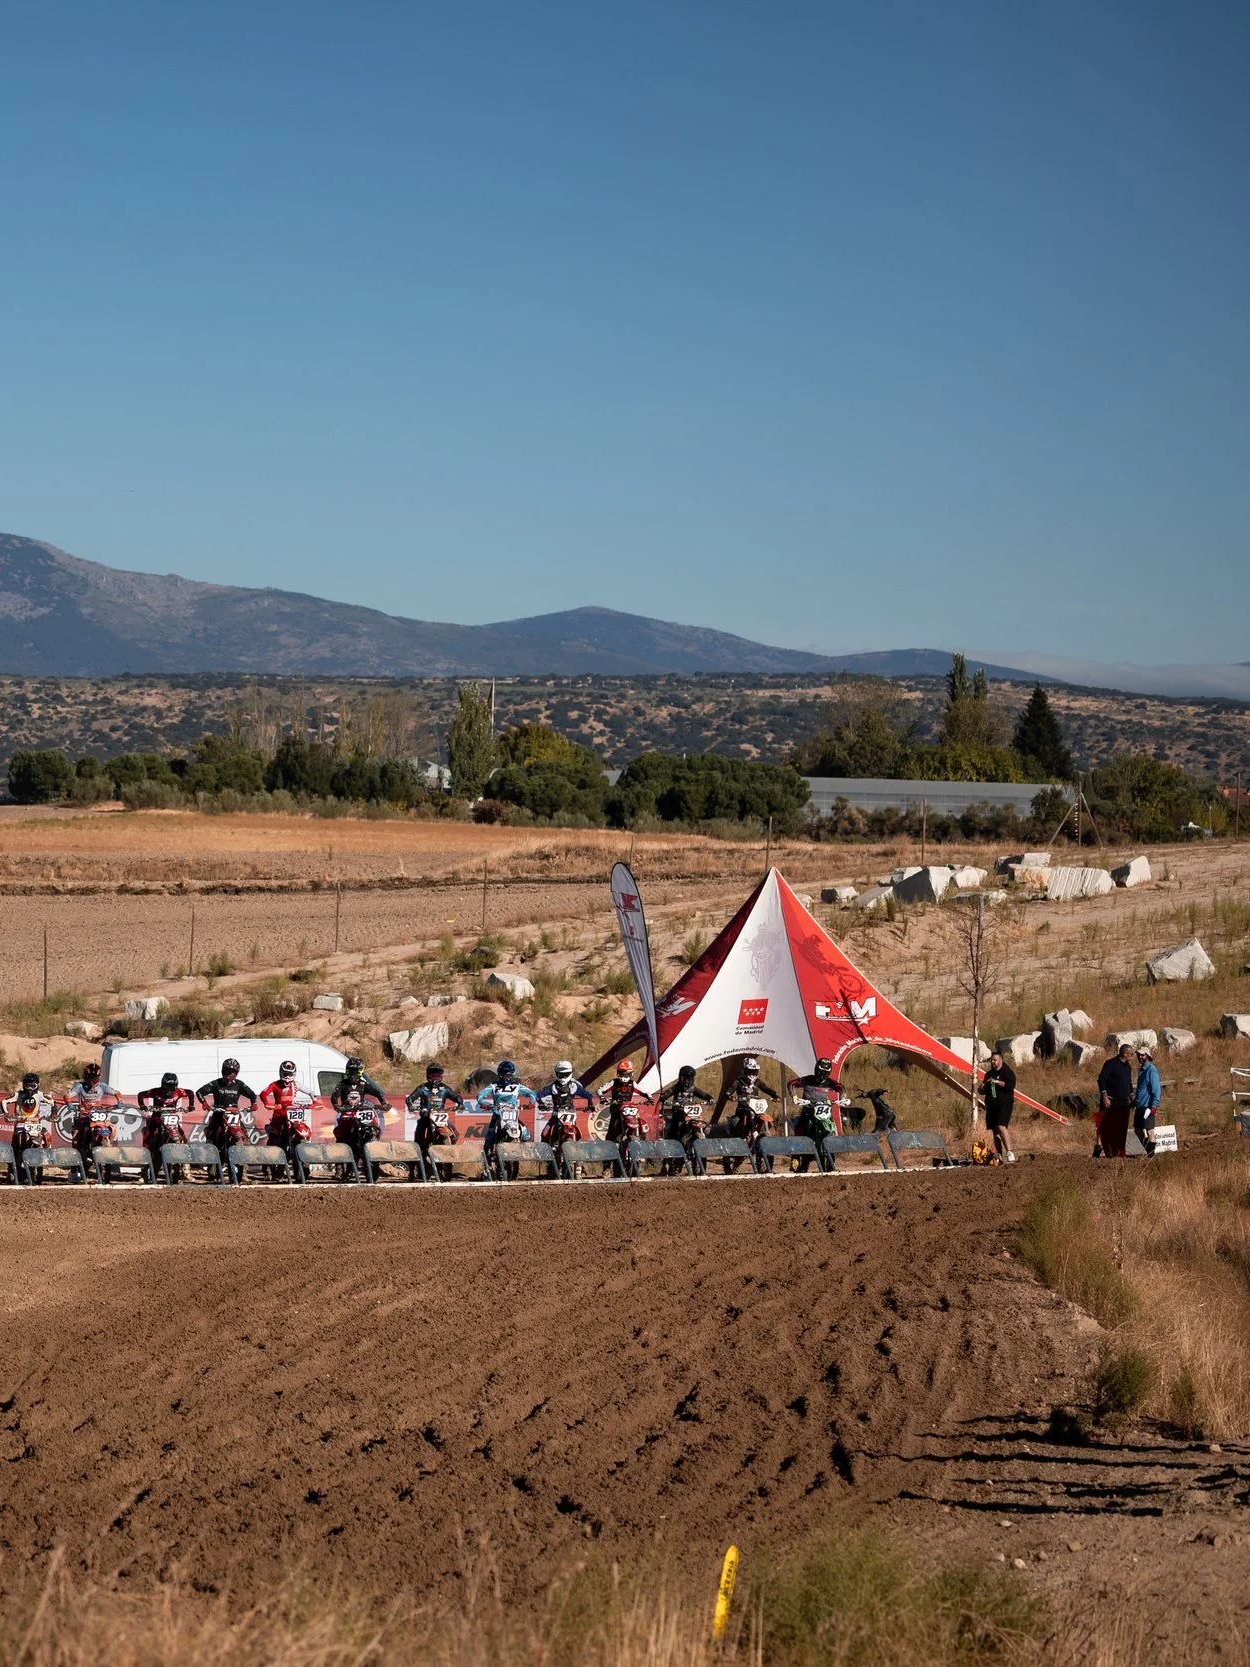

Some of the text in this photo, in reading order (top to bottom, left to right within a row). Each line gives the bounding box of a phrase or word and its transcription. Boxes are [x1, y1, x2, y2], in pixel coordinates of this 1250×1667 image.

[622, 1106, 638, 1116] 33
[687, 1106, 699, 1115] 29
[816, 1106, 830, 1115] 84
[91, 1112, 106, 1121] 39
[288, 1111, 303, 1120] 128
[434, 1113, 448, 1122] 72
